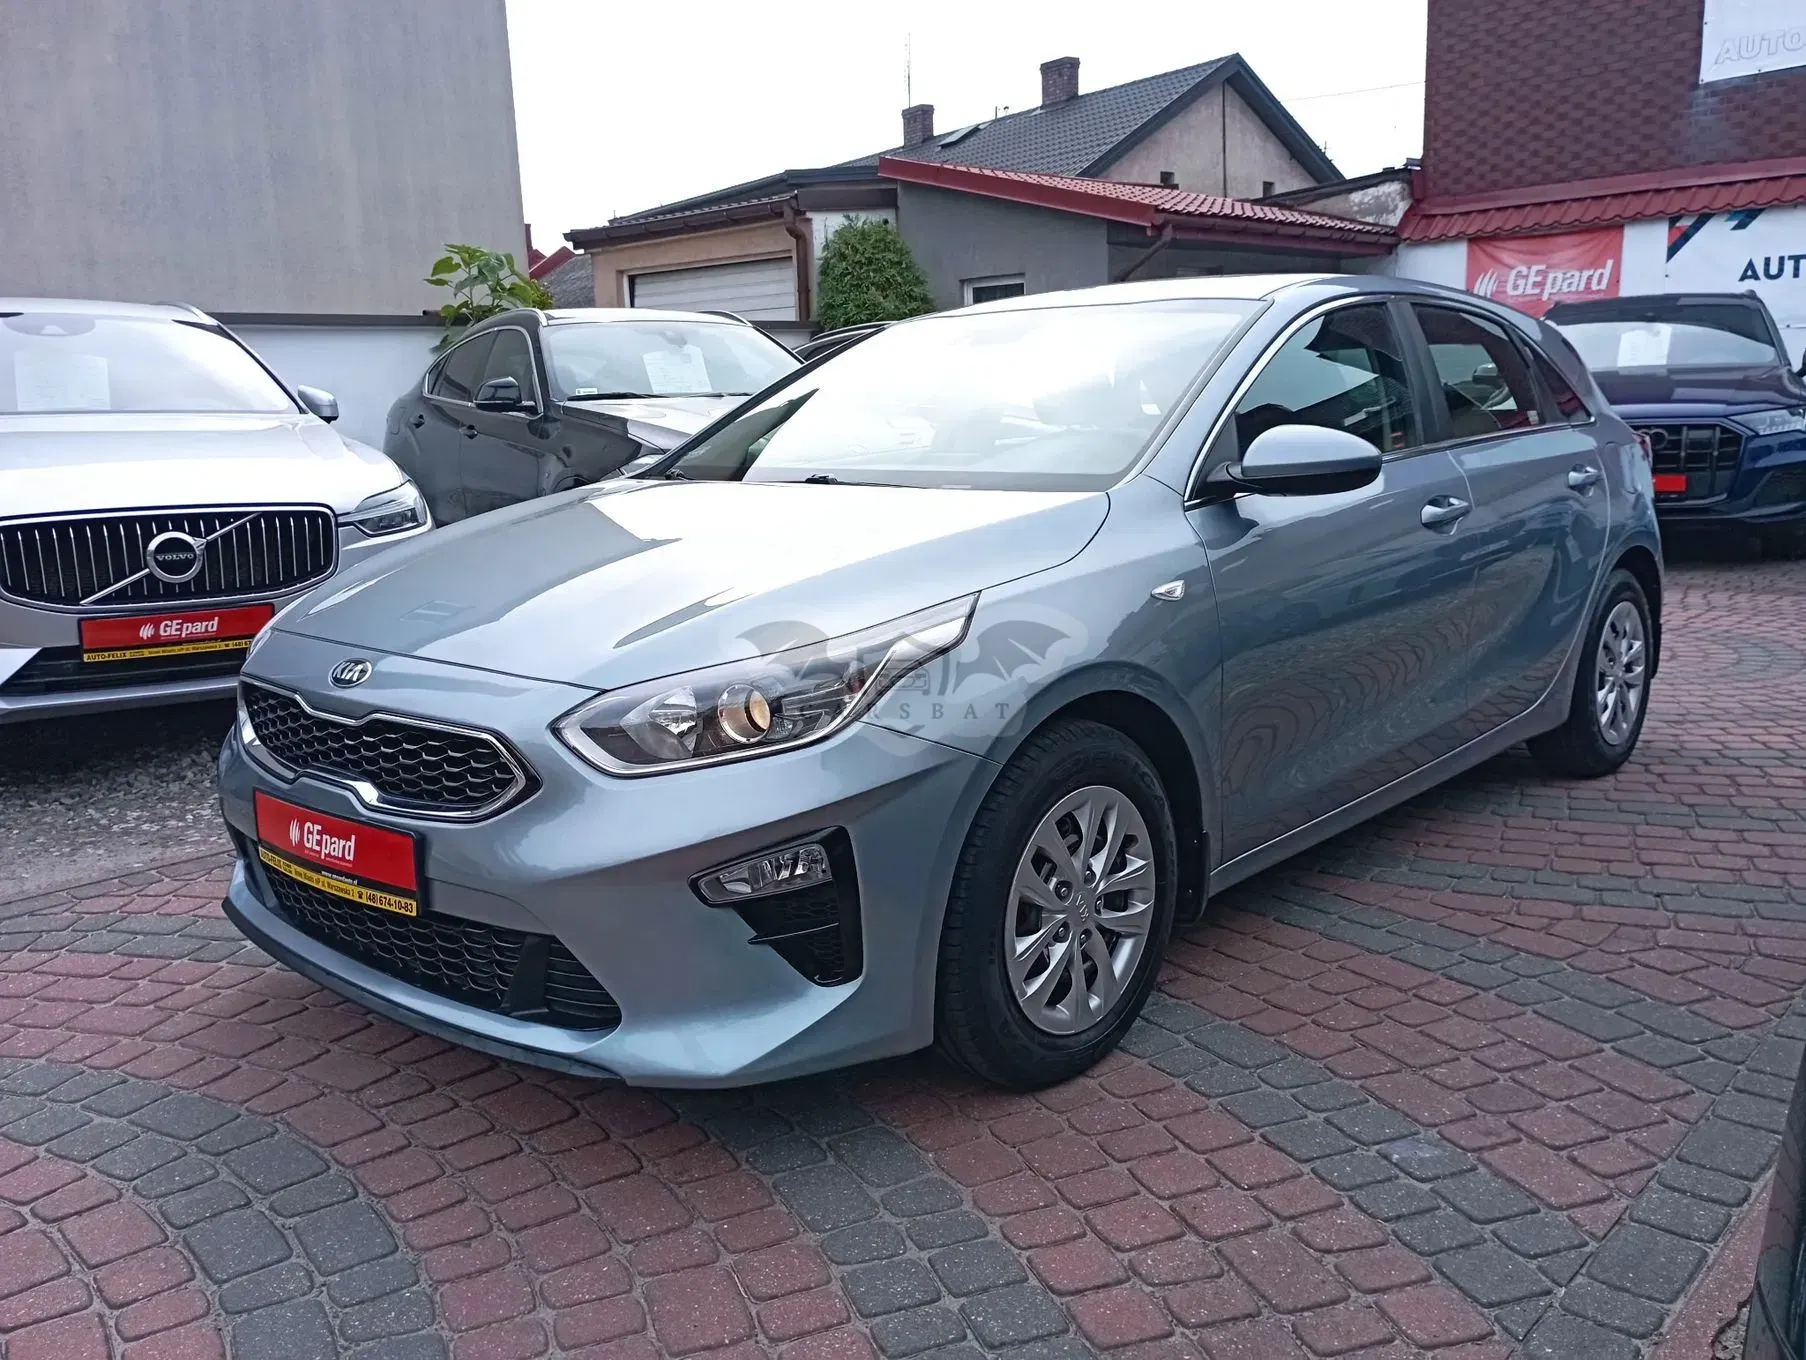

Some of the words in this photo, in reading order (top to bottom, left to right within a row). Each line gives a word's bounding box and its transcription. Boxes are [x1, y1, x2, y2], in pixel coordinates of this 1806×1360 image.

[1506, 259, 1613, 300] GEpard
[156, 553, 194, 561] VOLVO
[159, 617, 218, 638] GEpard
[333, 661, 364, 682] KIA
[303, 821, 356, 861] GEpard
[366, 891, 378, 905] (48)
[379, 895, 414, 913] 674-10-83
